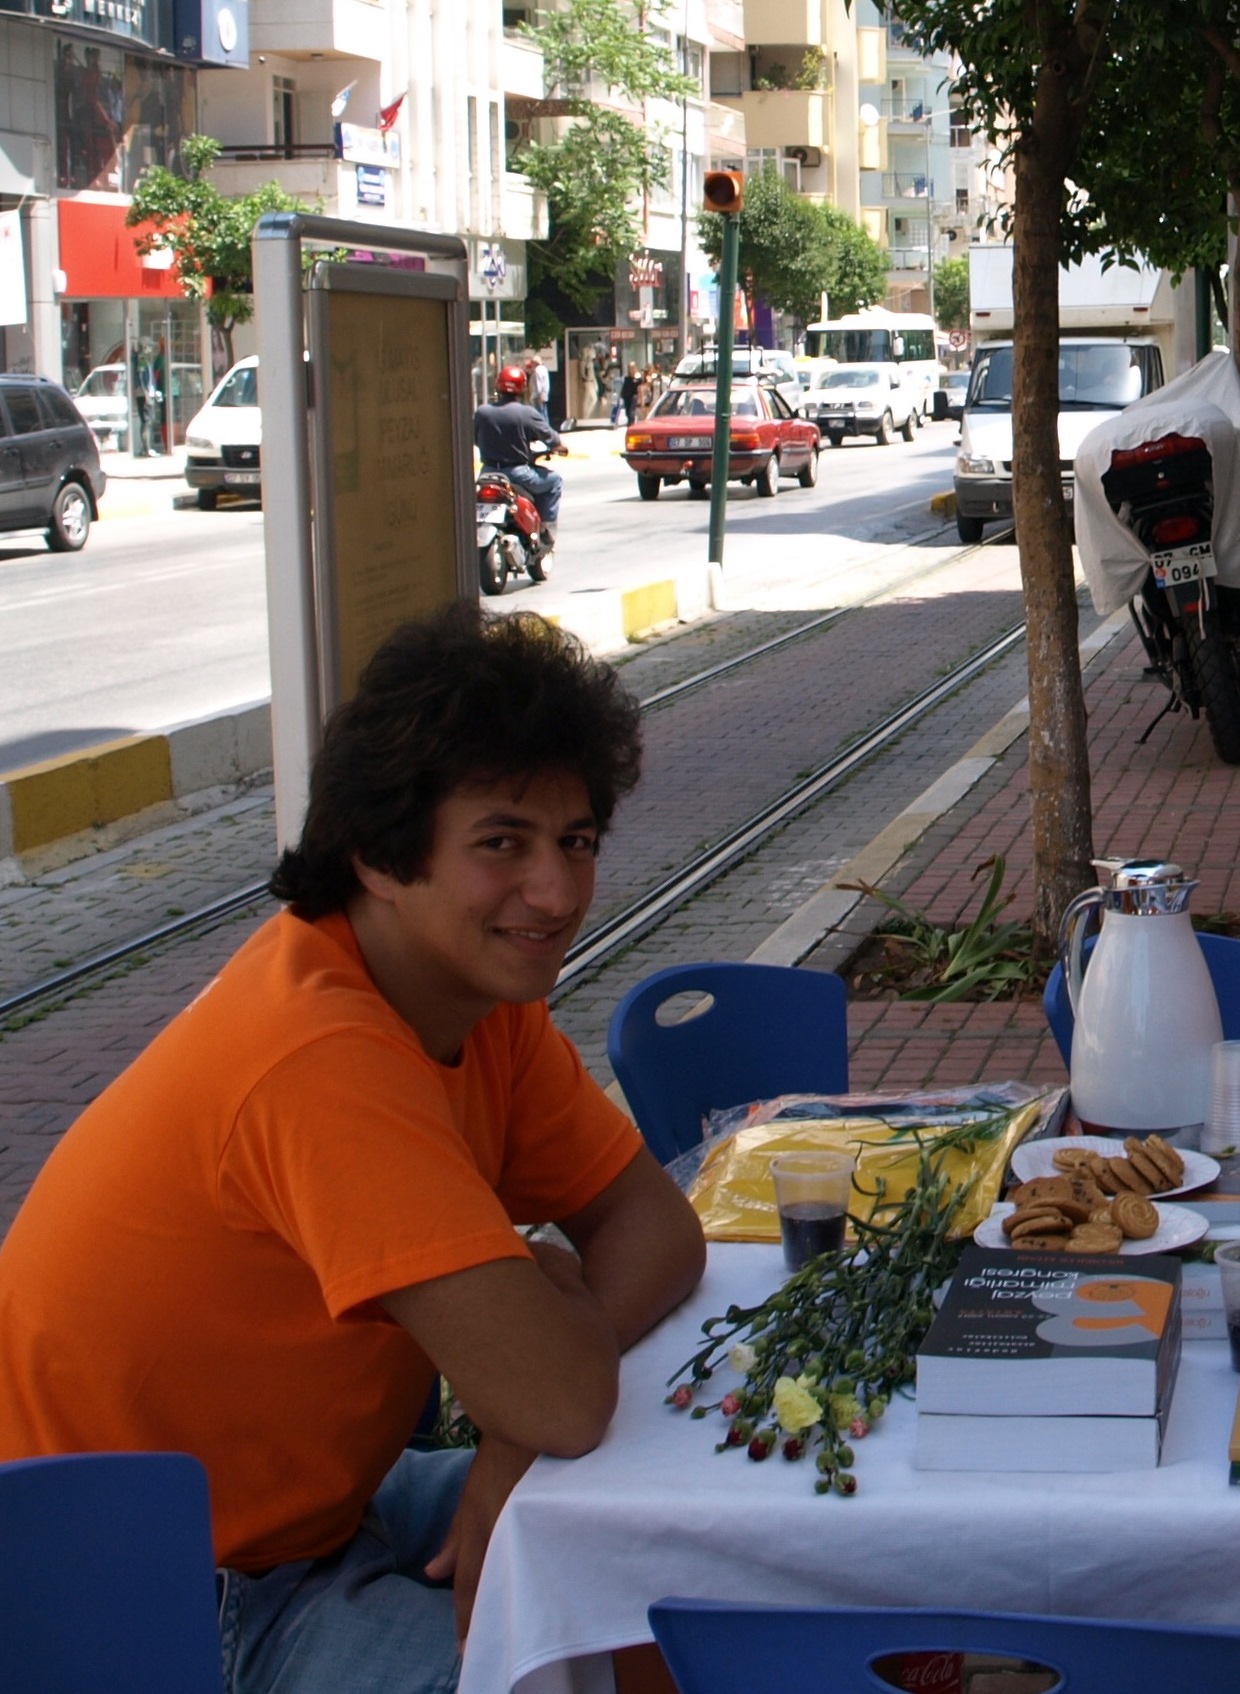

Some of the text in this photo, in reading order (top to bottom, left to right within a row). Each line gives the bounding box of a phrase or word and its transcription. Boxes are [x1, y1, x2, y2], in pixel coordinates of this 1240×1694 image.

[1155, 552, 1174, 568] 07
[981, 1268, 1080, 1281] kongresi
[964, 1276, 1075, 1289] mimarlığı
[991, 1289, 1073, 1301] peyzaj
